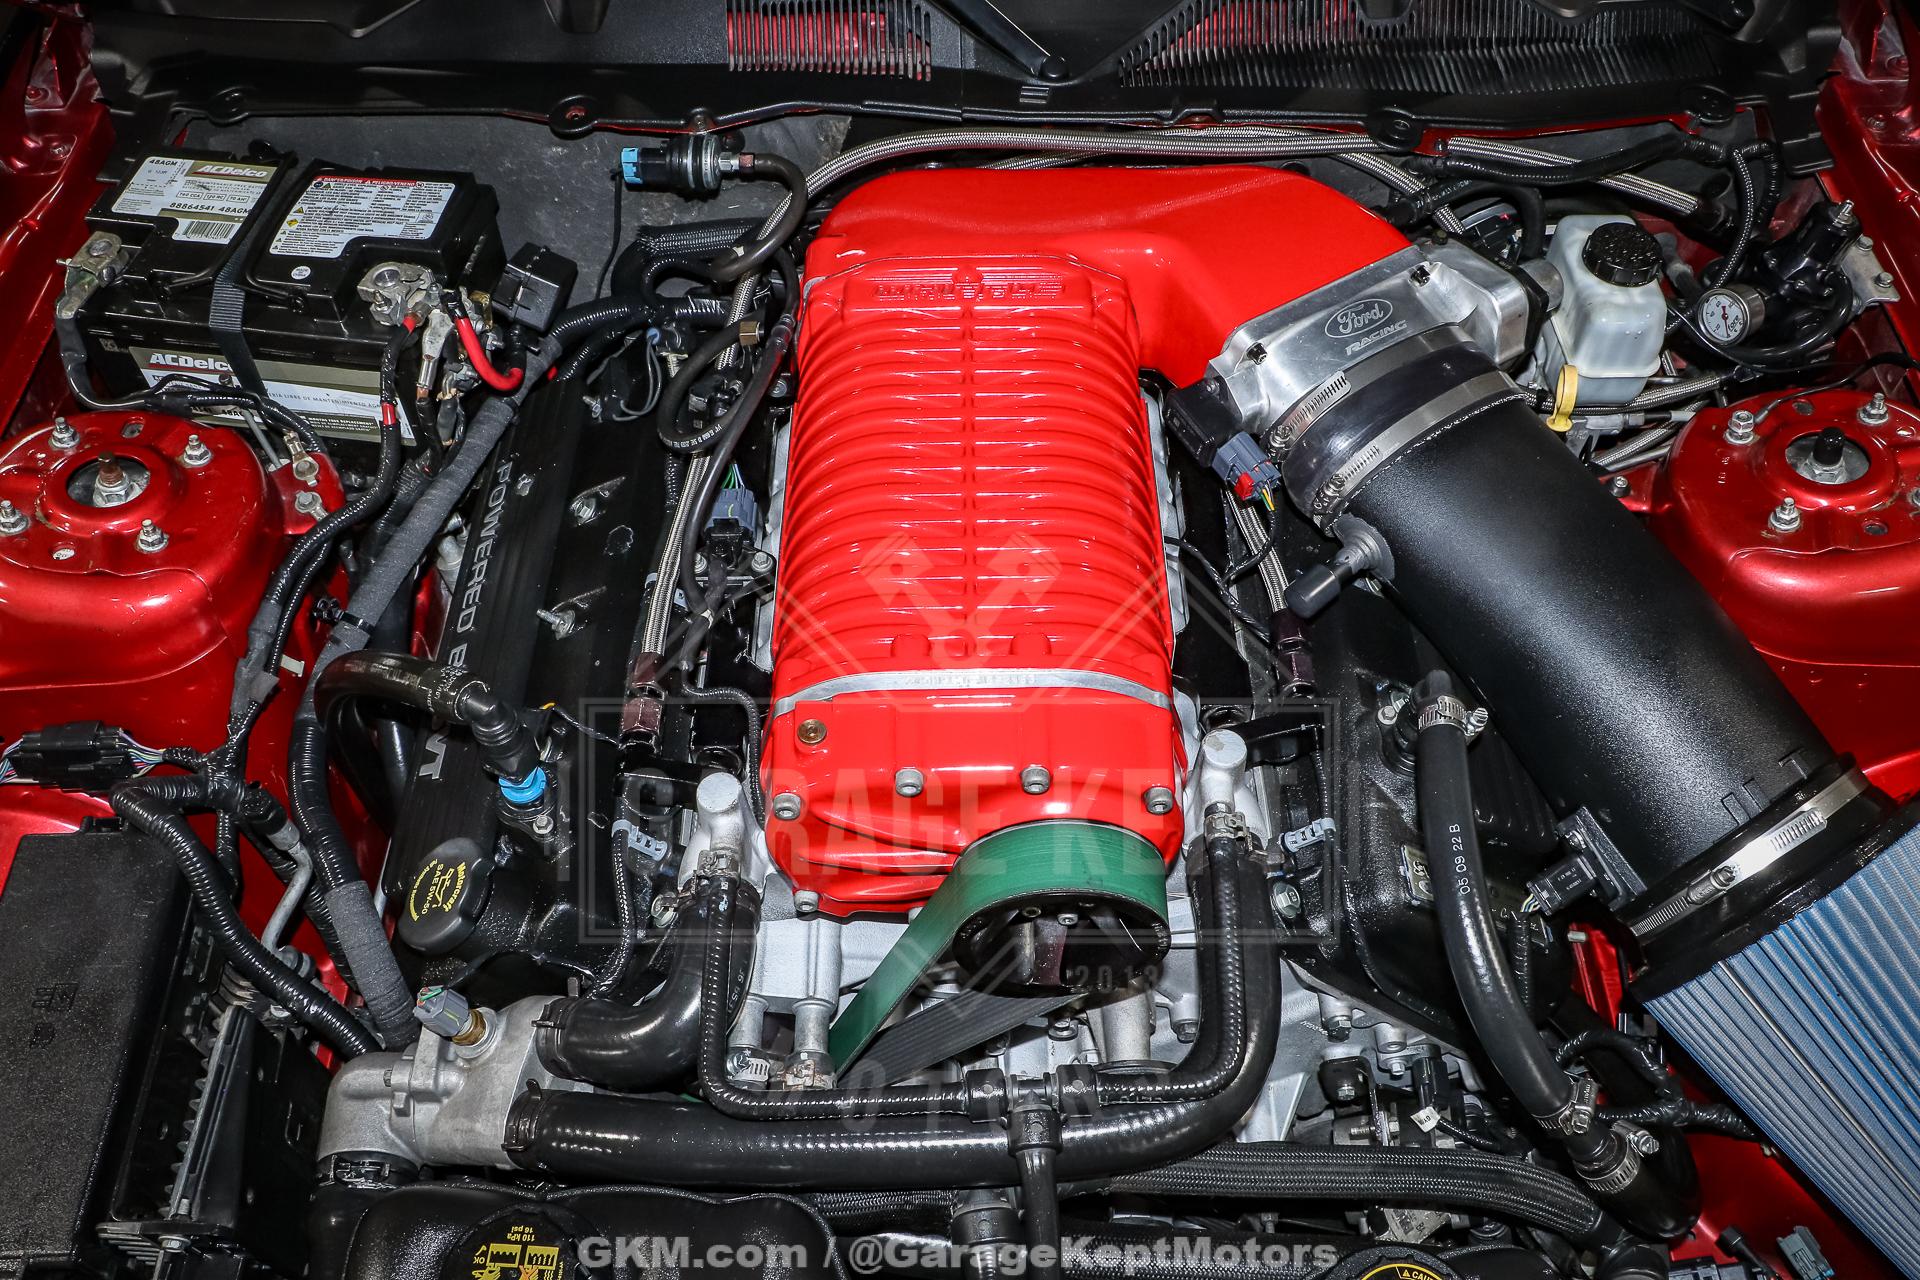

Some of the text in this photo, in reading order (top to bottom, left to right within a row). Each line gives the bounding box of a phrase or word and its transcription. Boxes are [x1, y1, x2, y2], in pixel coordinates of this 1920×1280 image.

[197, 164, 268, 178] ACDelco
[1336, 303, 1384, 334] Ford
[1344, 320, 1408, 356] RACING
[149, 352, 233, 372] ACDelc
[456, 461, 513, 634] POWERED
[1448, 823, 1471, 895] 05 09 22 B
[431, 863, 444, 885] SAE
[443, 862, 467, 912] Motorcraft
[421, 886, 437, 915] 5W-50
[506, 1233, 536, 1242] 110 kPa
[511, 1225, 524, 1234] psi
[473, 1256, 486, 1265] OK
